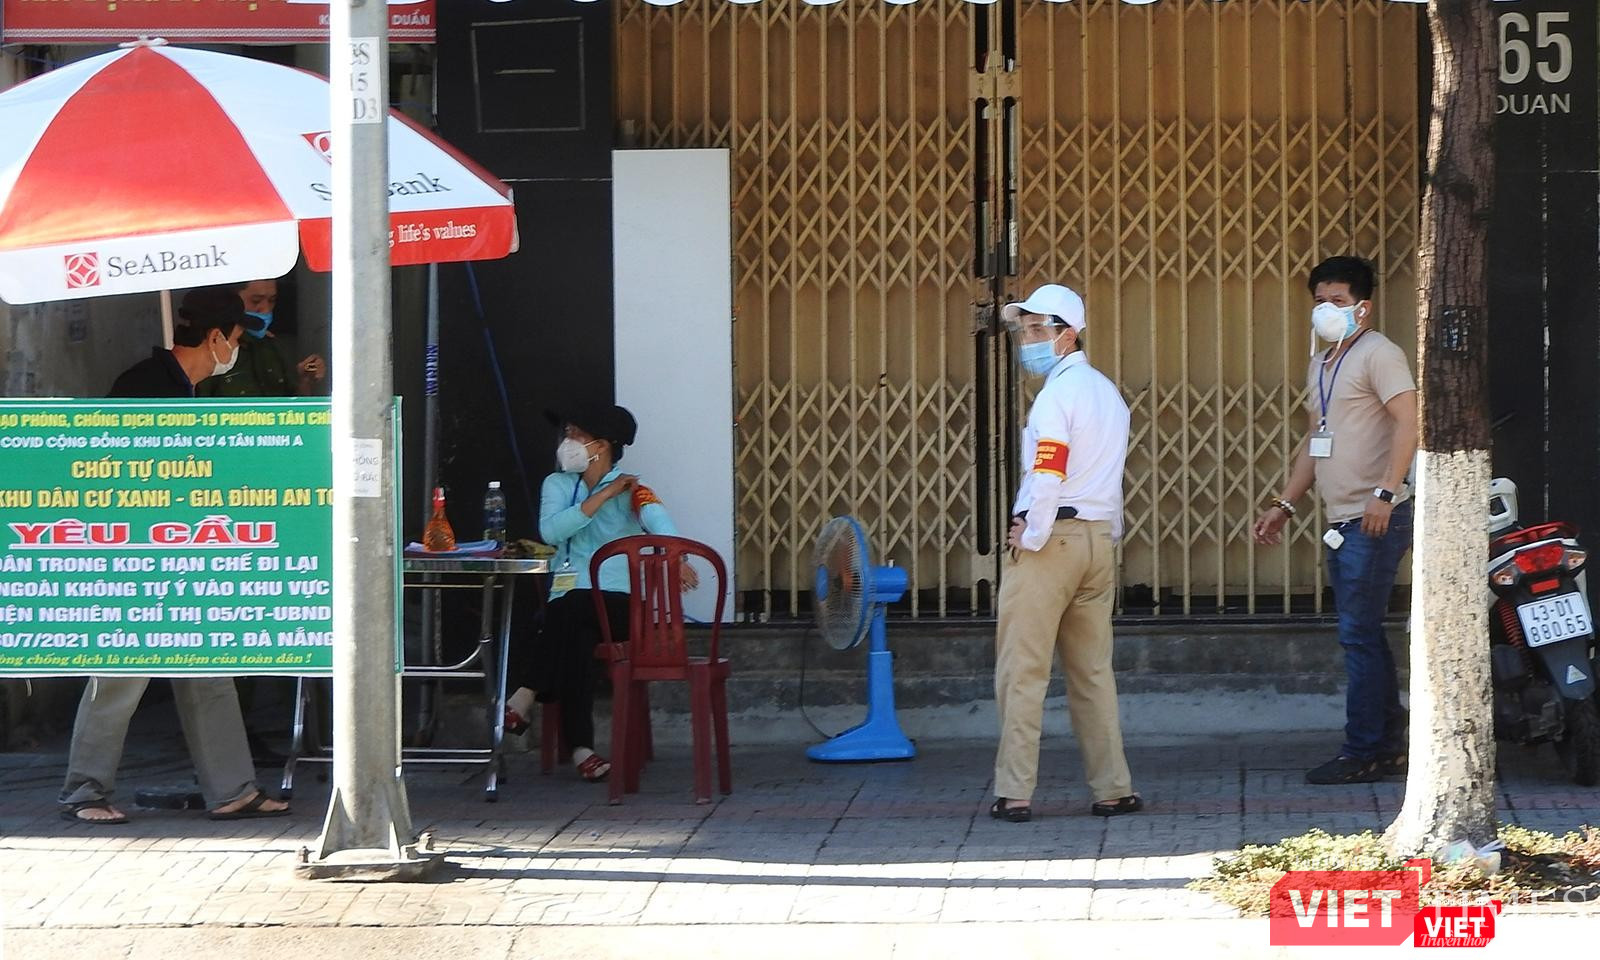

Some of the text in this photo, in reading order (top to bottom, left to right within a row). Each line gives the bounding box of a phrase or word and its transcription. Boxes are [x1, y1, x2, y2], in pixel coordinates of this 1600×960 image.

[398, 223, 431, 243] life's
[433, 221, 477, 240] values
[107, 245, 228, 278] SeABank
[0, 413, 18, 430] ẠO
[73, 409, 120, 427] CHỐNG
[122, 413, 155, 429] DỊCH
[157, 412, 218, 427] COVID-19
[278, 410, 305, 425] TÂN
[1, 435, 44, 448] COVID
[46, 432, 88, 450] CỘNG
[134, 436, 160, 447] KHU
[163, 433, 192, 448] DÂN
[217, 435, 226, 447] 4
[227, 432, 254, 447] TÂN
[292, 434, 304, 447] A
[71, 454, 213, 482] CHỐT TỰ QUẢN
[37, 486, 80, 508] DÂN
[84, 488, 114, 508] CƯ
[116, 490, 172, 507] XANH
[190, 489, 224, 507] GIA
[228, 485, 278, 507] ĐÌNH
[282, 489, 312, 506] AN
[8, 514, 277, 544] YÊU CẦU
[0, 552, 319, 575] ÂN TRONG KDC HẠN CHẾ ĐI LẠI
[0, 578, 331, 600] NGOÀI KHÔNG TỰ Ý VÀO KHU VỰC
[0, 602, 332, 625] IỆN NGHIÊM CHỈ THỊ 05/CT-UBND
[1531, 598, 1574, 622] 43-D1
[0, 626, 333, 648] 0/7/2021 CỦA UBND TP. ĐÀ NẴNG
[1530, 614, 1587, 643] 880.65
[0, 653, 24, 667] òng
[26, 652, 70, 667] chống
[72, 653, 104, 668] dịch
[106, 652, 120, 665] là
[123, 652, 162, 665] trách
[164, 651, 210, 667] nhiệm
[275, 652, 303, 665] dân
